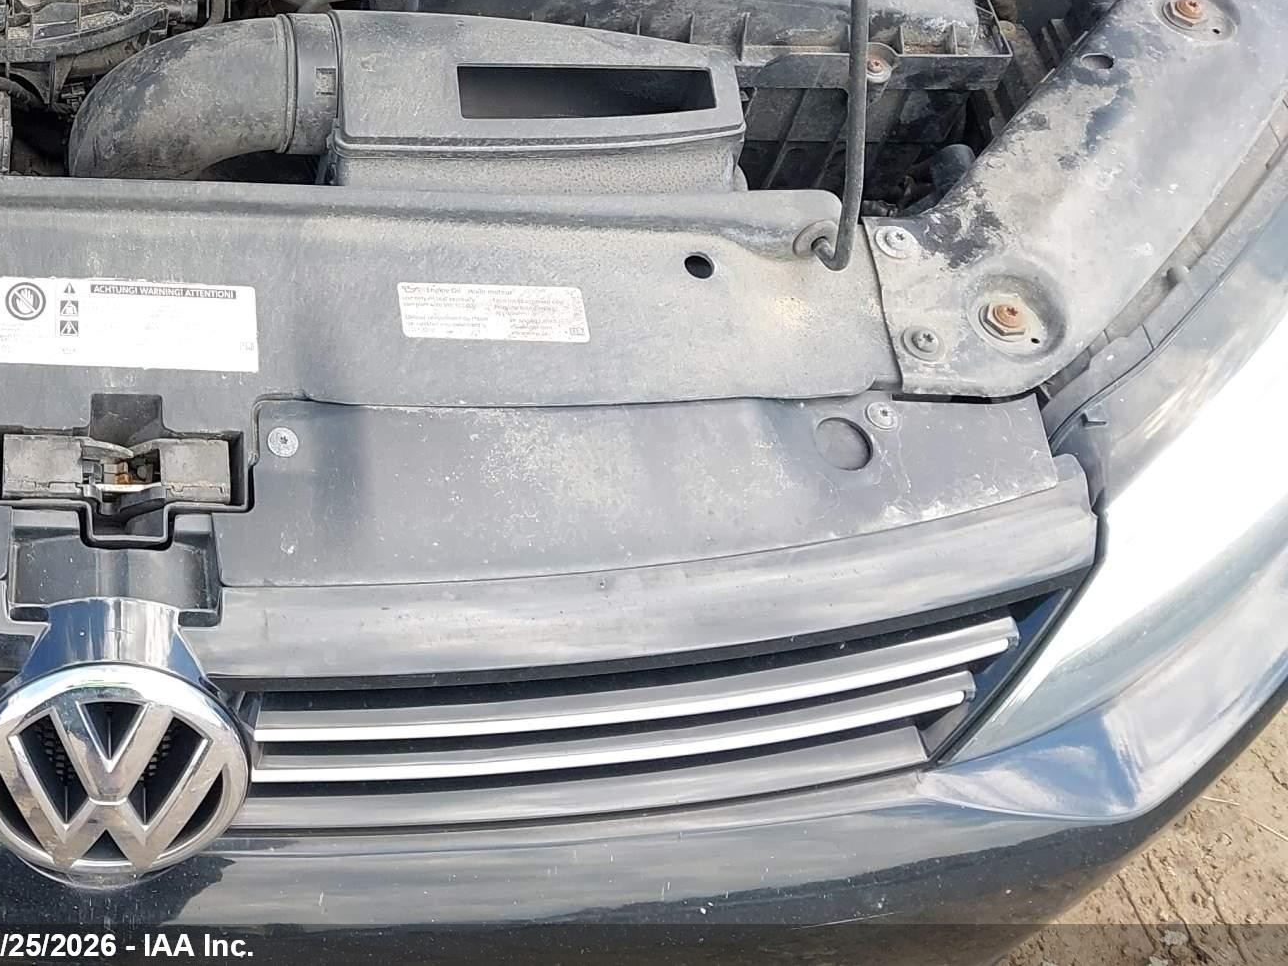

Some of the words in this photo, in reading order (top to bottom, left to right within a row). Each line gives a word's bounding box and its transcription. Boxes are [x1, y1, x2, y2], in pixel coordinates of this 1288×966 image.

[93, 285, 138, 295] ACHTUNG!
[139, 287, 184, 297] WARNING!
[184, 289, 234, 299] ATTENTION!
